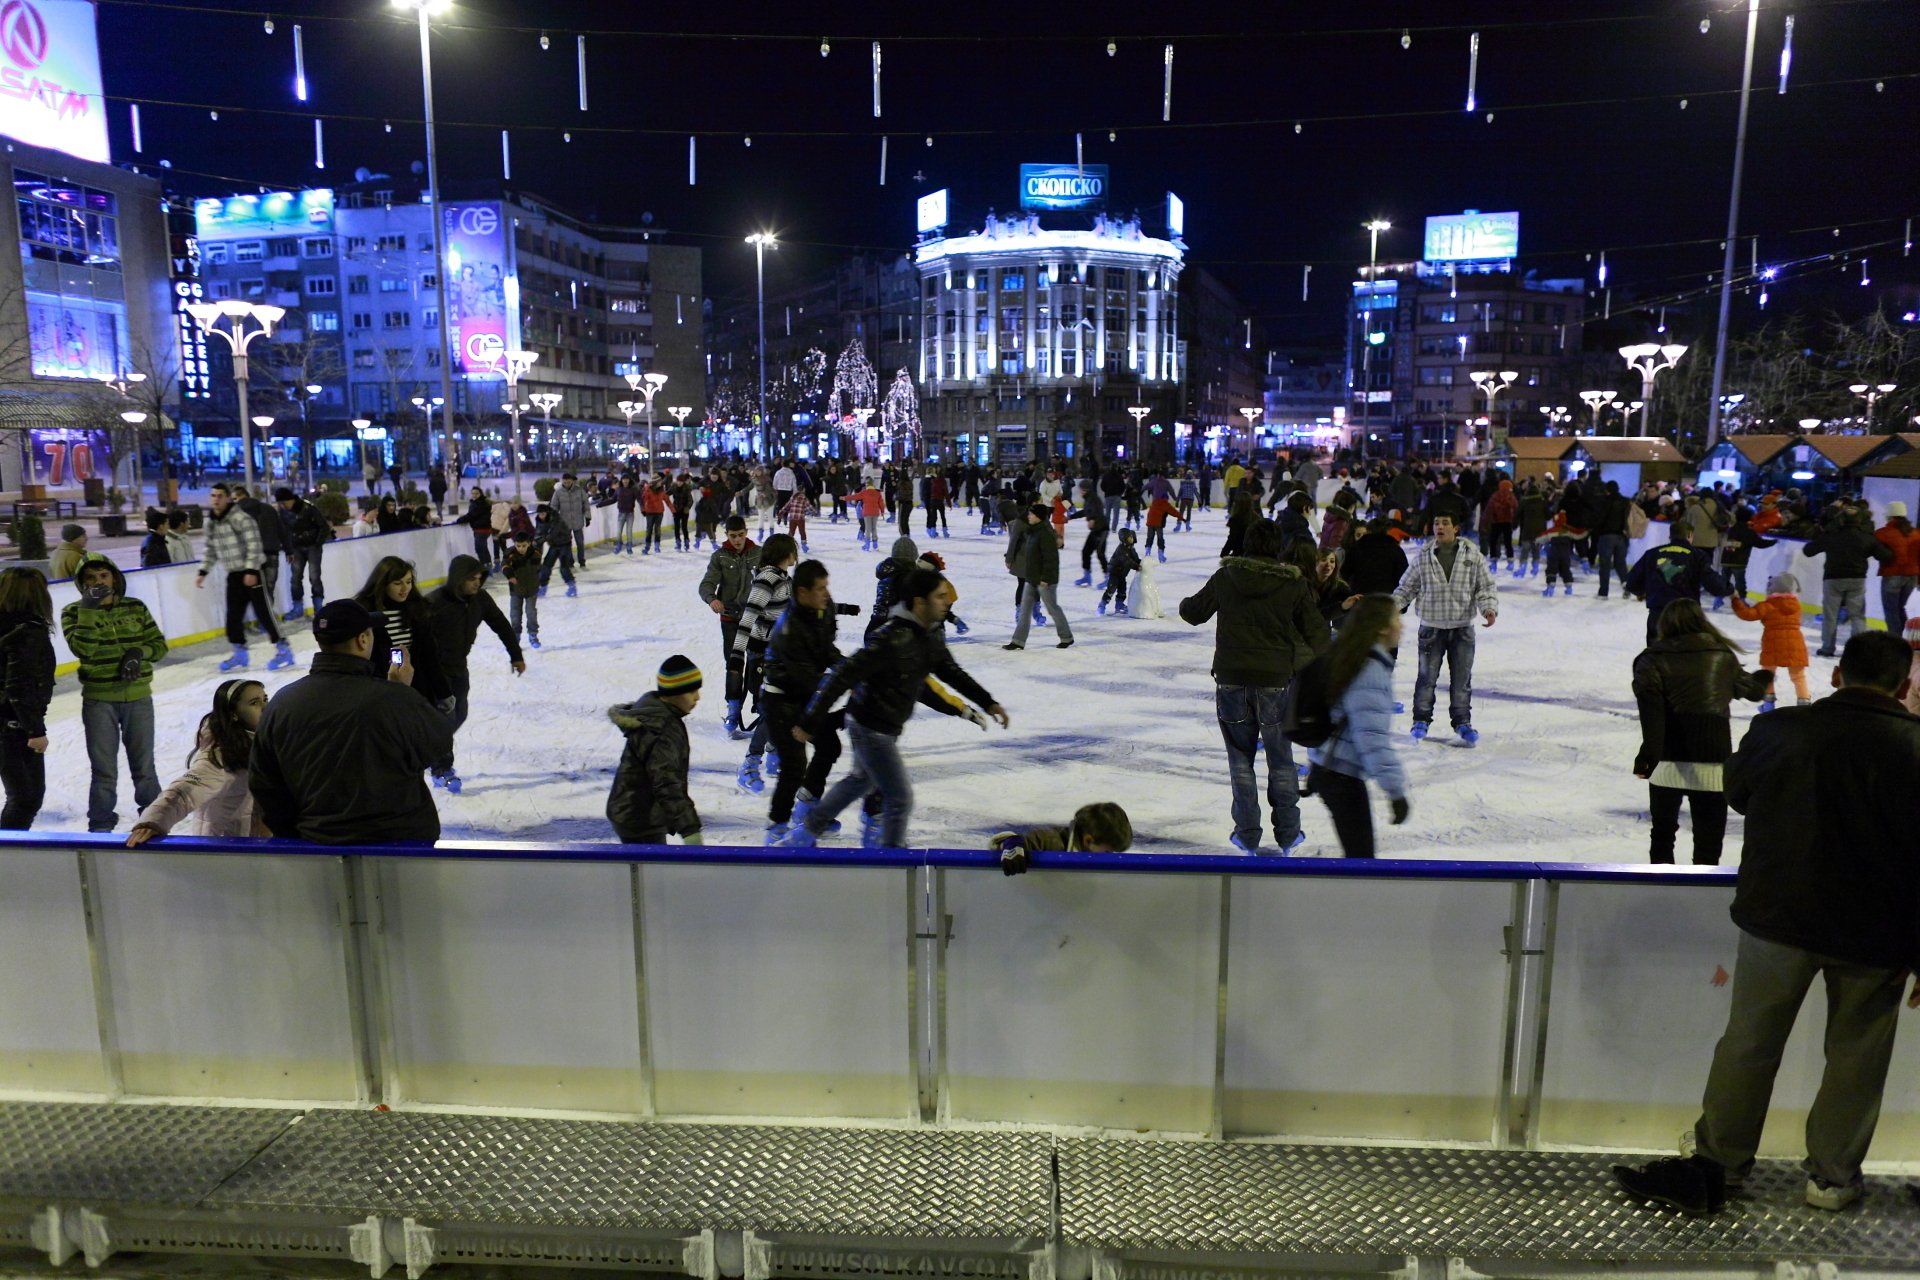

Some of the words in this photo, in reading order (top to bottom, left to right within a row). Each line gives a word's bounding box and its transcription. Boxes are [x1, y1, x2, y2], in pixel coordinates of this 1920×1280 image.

[1027, 177, 1102, 196] СКОПСКО
[176, 282, 197, 389] GALLERY
[191, 283, 209, 389] GLLERY
